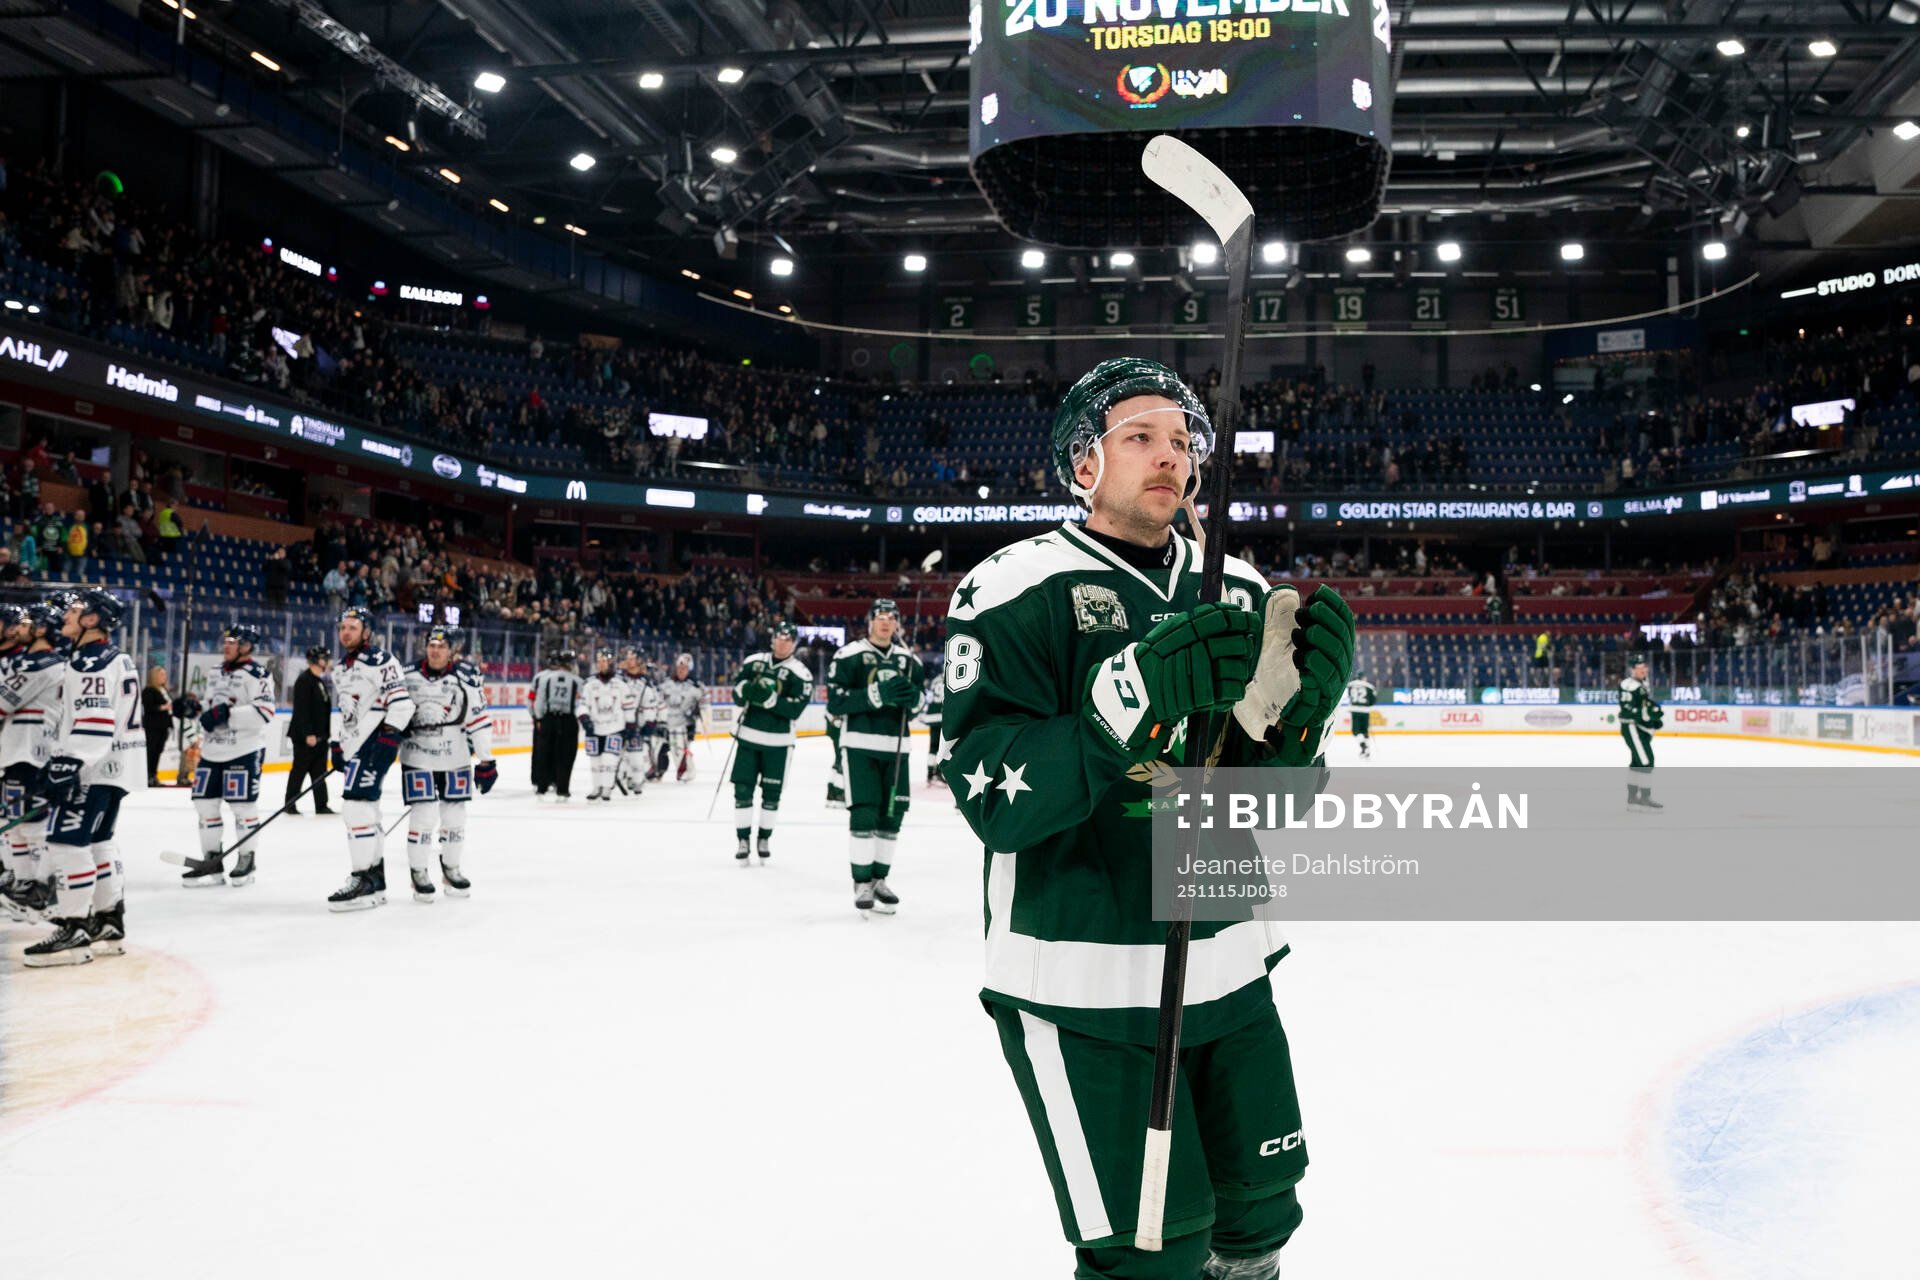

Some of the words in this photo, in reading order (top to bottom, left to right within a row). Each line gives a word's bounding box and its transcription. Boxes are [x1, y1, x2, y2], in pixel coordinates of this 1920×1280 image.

[1091, 20, 1201, 51] TORSDAG
[1209, 17, 1271, 43] 19:00
[1818, 272, 1876, 295] STUDIO
[949, 304, 965, 327] 2
[1027, 302, 1041, 325] 5
[1105, 301, 1120, 324] 9
[1184, 299, 1198, 322] 9
[1259, 298, 1281, 320] 17
[1338, 295, 1362, 320] 19
[1416, 296, 1440, 319] 21
[1495, 296, 1520, 319] 51
[106, 364, 178, 402] Helmia
[913, 505, 965, 522] GOLDEN
[972, 504, 1006, 521] STAR
[1339, 502, 1400, 519] GOLDEN
[1402, 502, 1437, 518] STAR
[1439, 502, 1529, 518] RESTAURANG
[1531, 502, 1544, 518] &
[1546, 502, 1576, 517] BAR
[82, 677, 105, 695] 28
[380, 667, 398, 682] 23
[1441, 713, 1481, 723] JULA
[1675, 709, 1728, 723] BORGA
